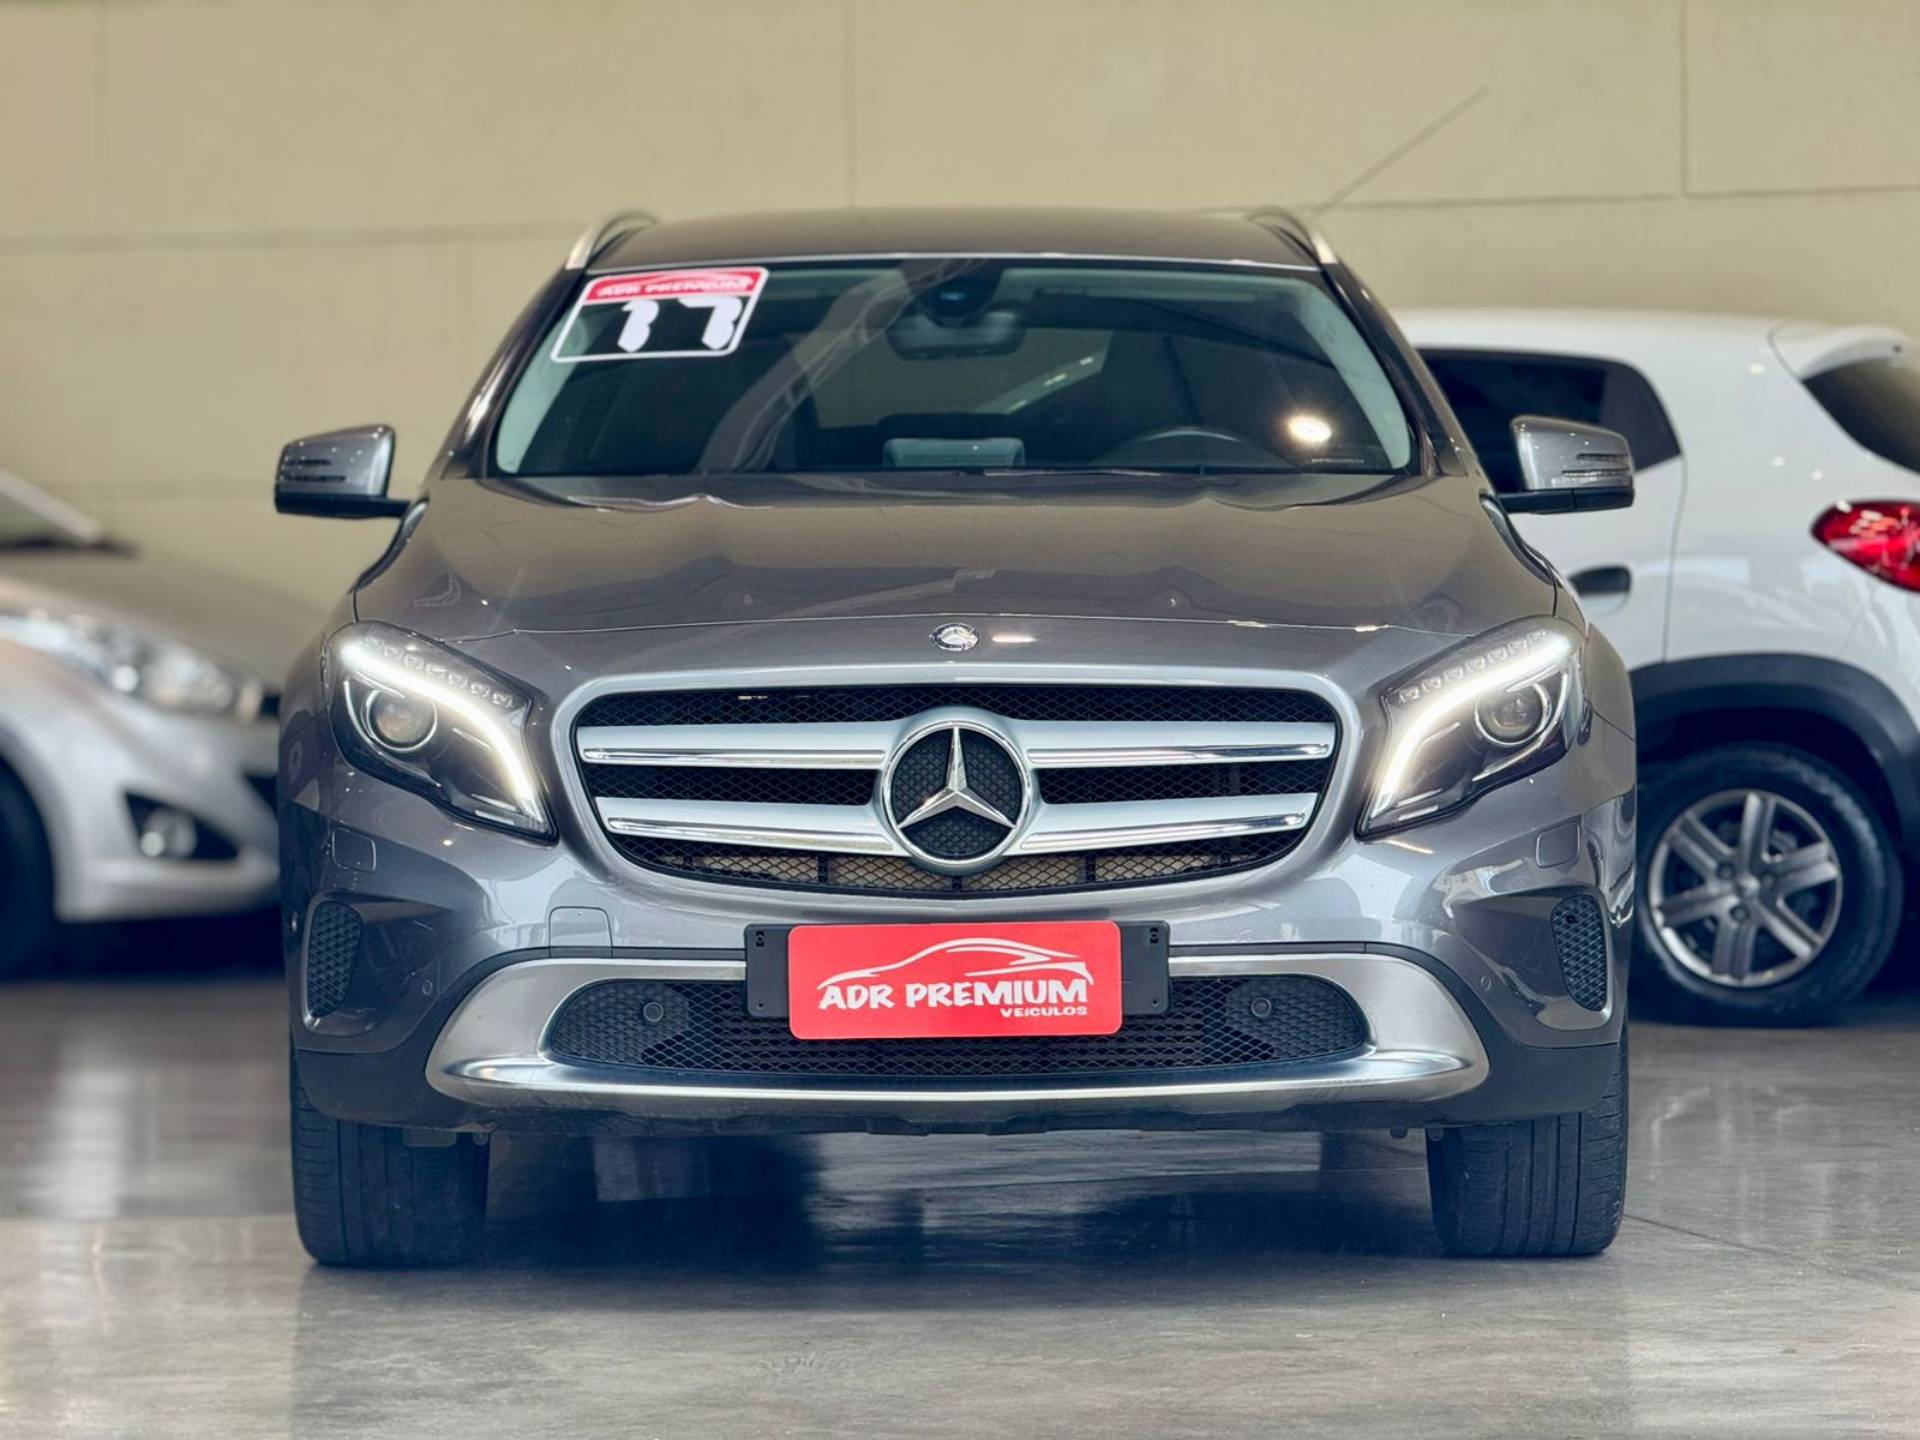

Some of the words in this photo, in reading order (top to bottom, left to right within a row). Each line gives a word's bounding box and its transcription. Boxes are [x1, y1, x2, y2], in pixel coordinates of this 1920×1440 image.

[617, 296, 742, 352] 17
[818, 984, 895, 1010] ADR
[905, 978, 1088, 1008] PREMIUM
